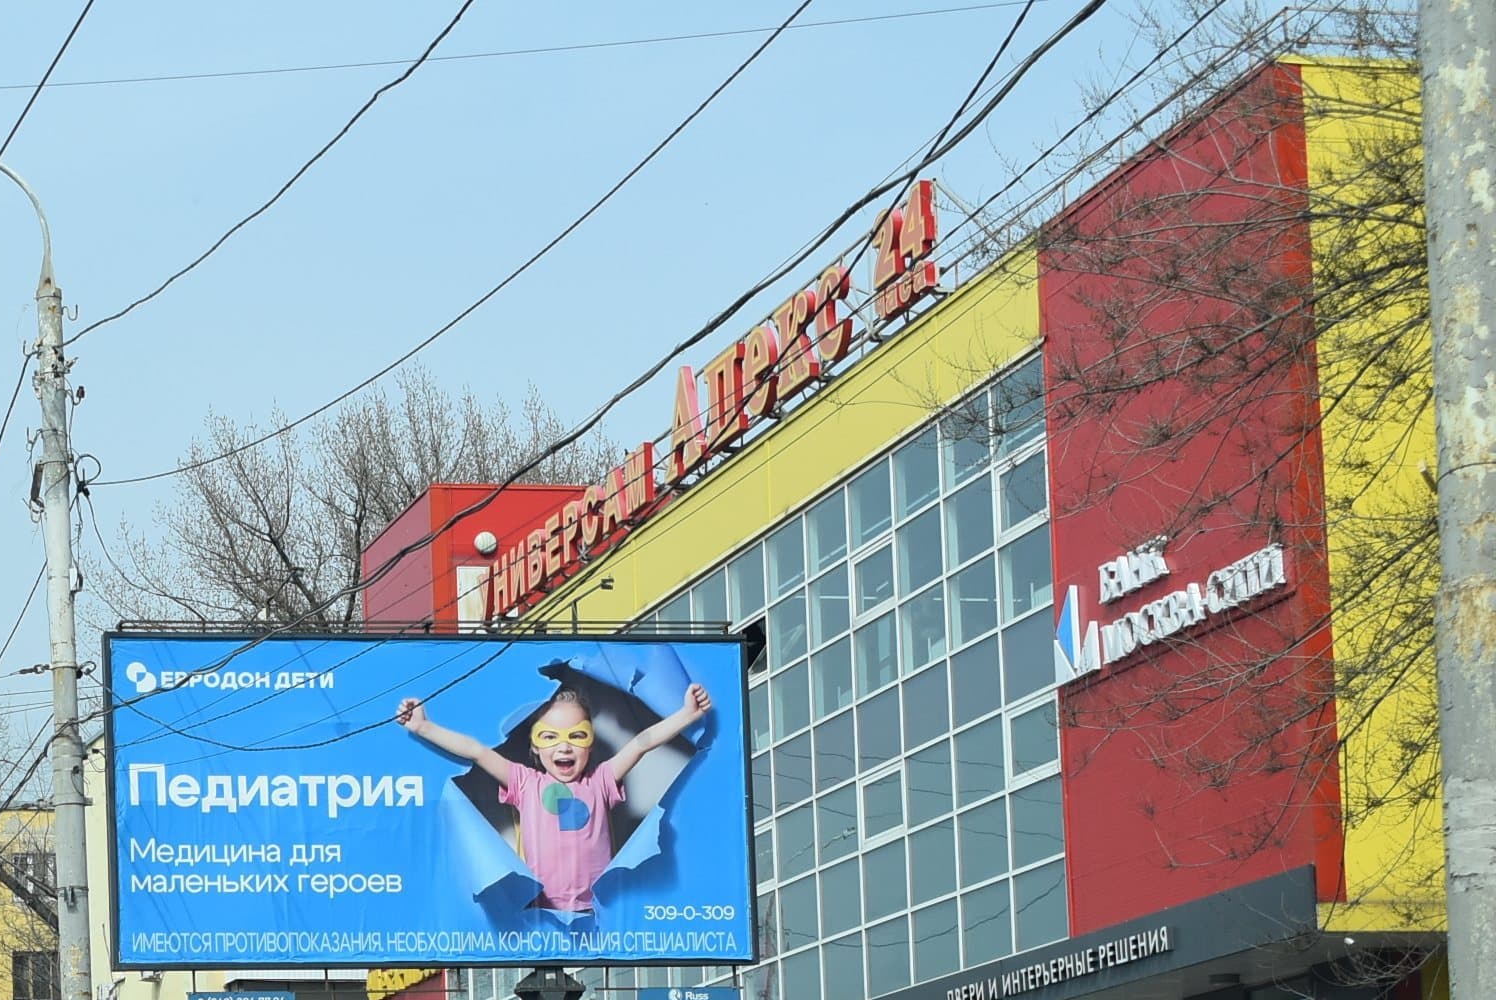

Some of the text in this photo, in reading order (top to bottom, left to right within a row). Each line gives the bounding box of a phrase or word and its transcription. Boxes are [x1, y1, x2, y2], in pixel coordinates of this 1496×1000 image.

[872, 179, 935, 290] 24
[160, 670, 334, 691] ЕВРОДОН ДЕТИ
[128, 763, 424, 818] Педиатрия
[129, 837, 342, 867] Медицина для
[131, 873, 403, 898] маленьких героев
[643, 905, 735, 921] 309-0-309
[132, 930, 737, 953] ИМЕЮТСЯ ПРОТИВОПОКАЗАНИЯ. НЕОБХОДИМА КОНСУЛЬТАЦИЯ СПЕЦИАЛИСТА
[1003, 949, 1094, 996] ИНТЕРЬЕРНЫЕ
[1099, 926, 1170, 969] РЕШЕНИЯ
[685, 991, 709, 1000] Russ
